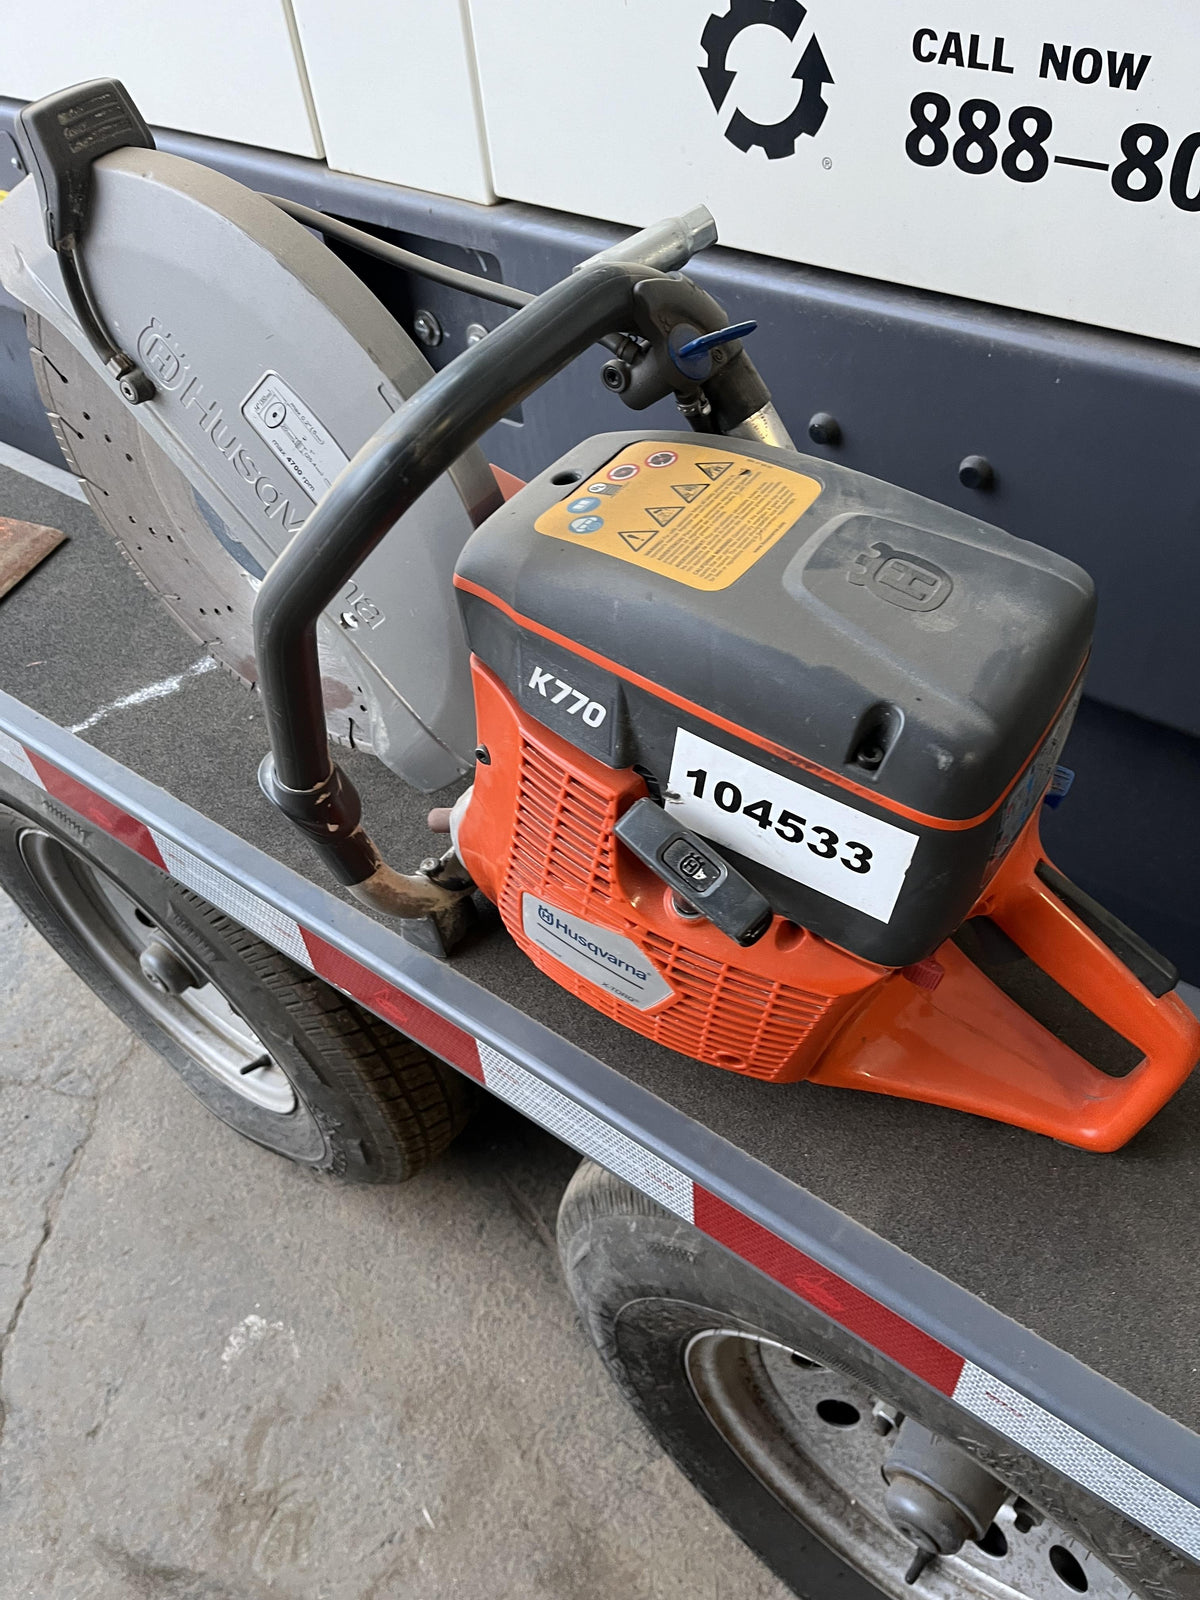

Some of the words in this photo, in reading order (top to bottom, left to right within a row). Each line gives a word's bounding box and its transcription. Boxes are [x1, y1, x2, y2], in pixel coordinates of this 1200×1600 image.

[912, 28, 1014, 74] CALL
[1039, 42, 1152, 91] NOW
[286, 456, 303, 476] 4700
[302, 476, 315, 492] rpm
[528, 666, 607, 728] K770
[686, 768, 873, 874] 104533
[556, 918, 647, 981] Husqvarna
